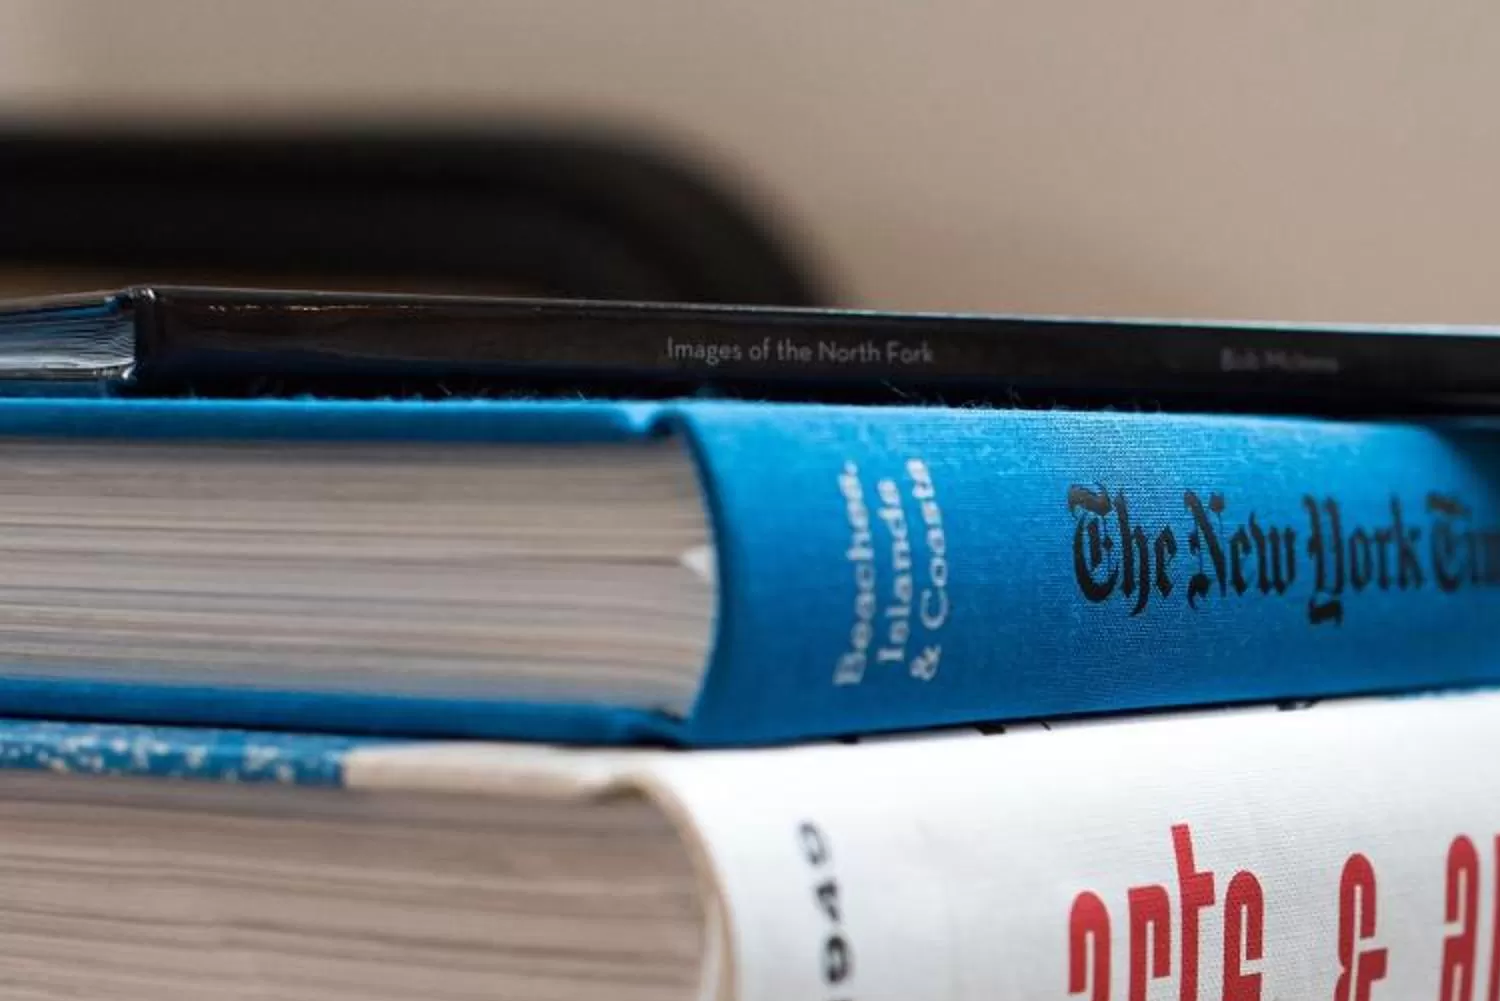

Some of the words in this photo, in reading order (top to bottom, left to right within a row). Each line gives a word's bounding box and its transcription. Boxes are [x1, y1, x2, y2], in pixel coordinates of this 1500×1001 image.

[667, 336, 742, 366] Images
[750, 337, 771, 361] of
[777, 338, 812, 362] the
[818, 340, 881, 363] North
[886, 340, 934, 364] Fork
[876, 478, 913, 663] Islands
[907, 458, 949, 630] Coasts
[1068, 482, 1178, 617] The
[1184, 488, 1296, 609] New
[1303, 494, 1424, 626] York
[909, 644, 941, 681] &
